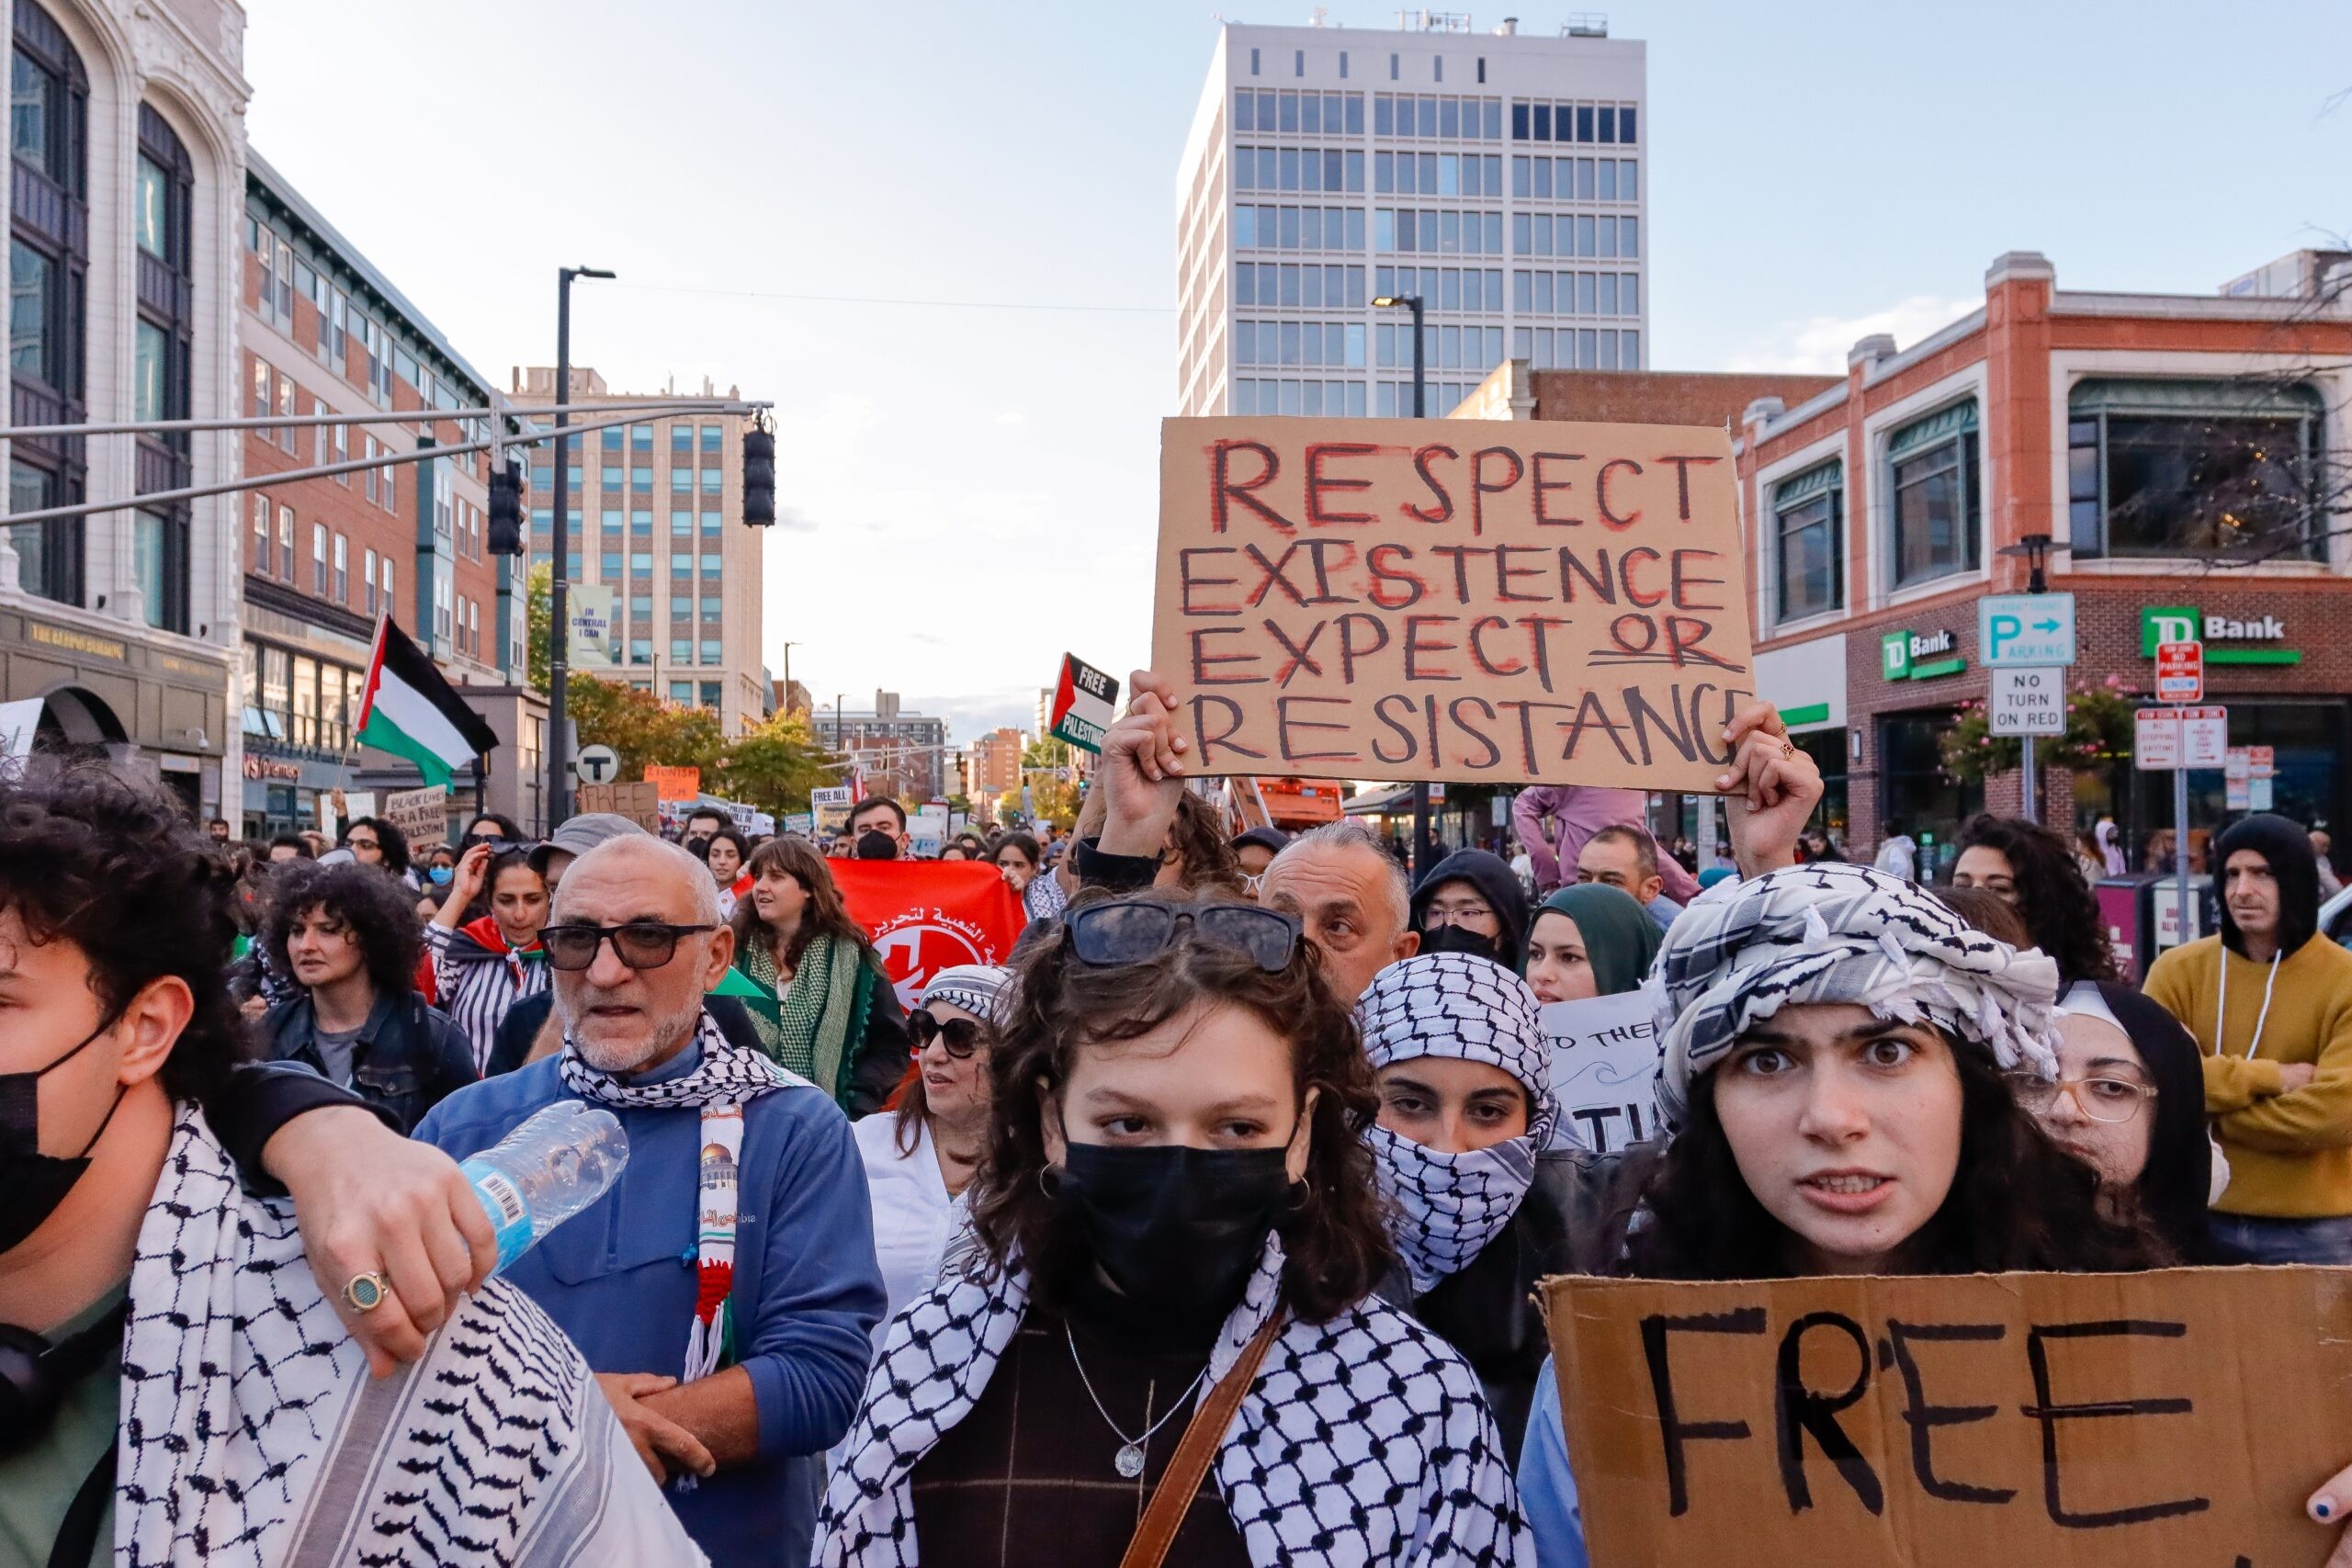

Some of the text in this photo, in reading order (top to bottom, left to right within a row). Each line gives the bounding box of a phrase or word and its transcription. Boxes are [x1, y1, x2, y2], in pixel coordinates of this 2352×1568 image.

[1205, 439, 1724, 536] RESPECT
[1179, 538, 1725, 615] EXISTENCE
[584, 607, 594, 616] IN
[571, 617, 607, 627] CENTRAL
[2150, 615, 2285, 643] TD Bank
[584, 629, 599, 638] CAN
[1183, 612, 1746, 693] EXPECT OR
[1885, 629, 1951, 669] TD Bank
[2171, 653, 2186, 661] NO
[1079, 665, 1107, 696] FREE
[2014, 675, 2041, 687] NO
[2007, 694, 2050, 706] TURN
[1997, 713, 2059, 726] ON RED
[243, 753, 300, 783] VS/pharmacy
[583, 757, 611, 780] T
[647, 768, 697, 779] ZIONISM
[391, 795, 422, 809] BLACK
[584, 784, 657, 814] FREE
[814, 790, 845, 802] FREE ALL
[409, 811, 416, 822] A
[418, 807, 441, 820] FREE
[729, 806, 753, 815] PALESTINE
[745, 814, 753, 823] BE
[1588, 1021, 1654, 1047] THE
[1640, 1307, 2210, 1529] FREE
